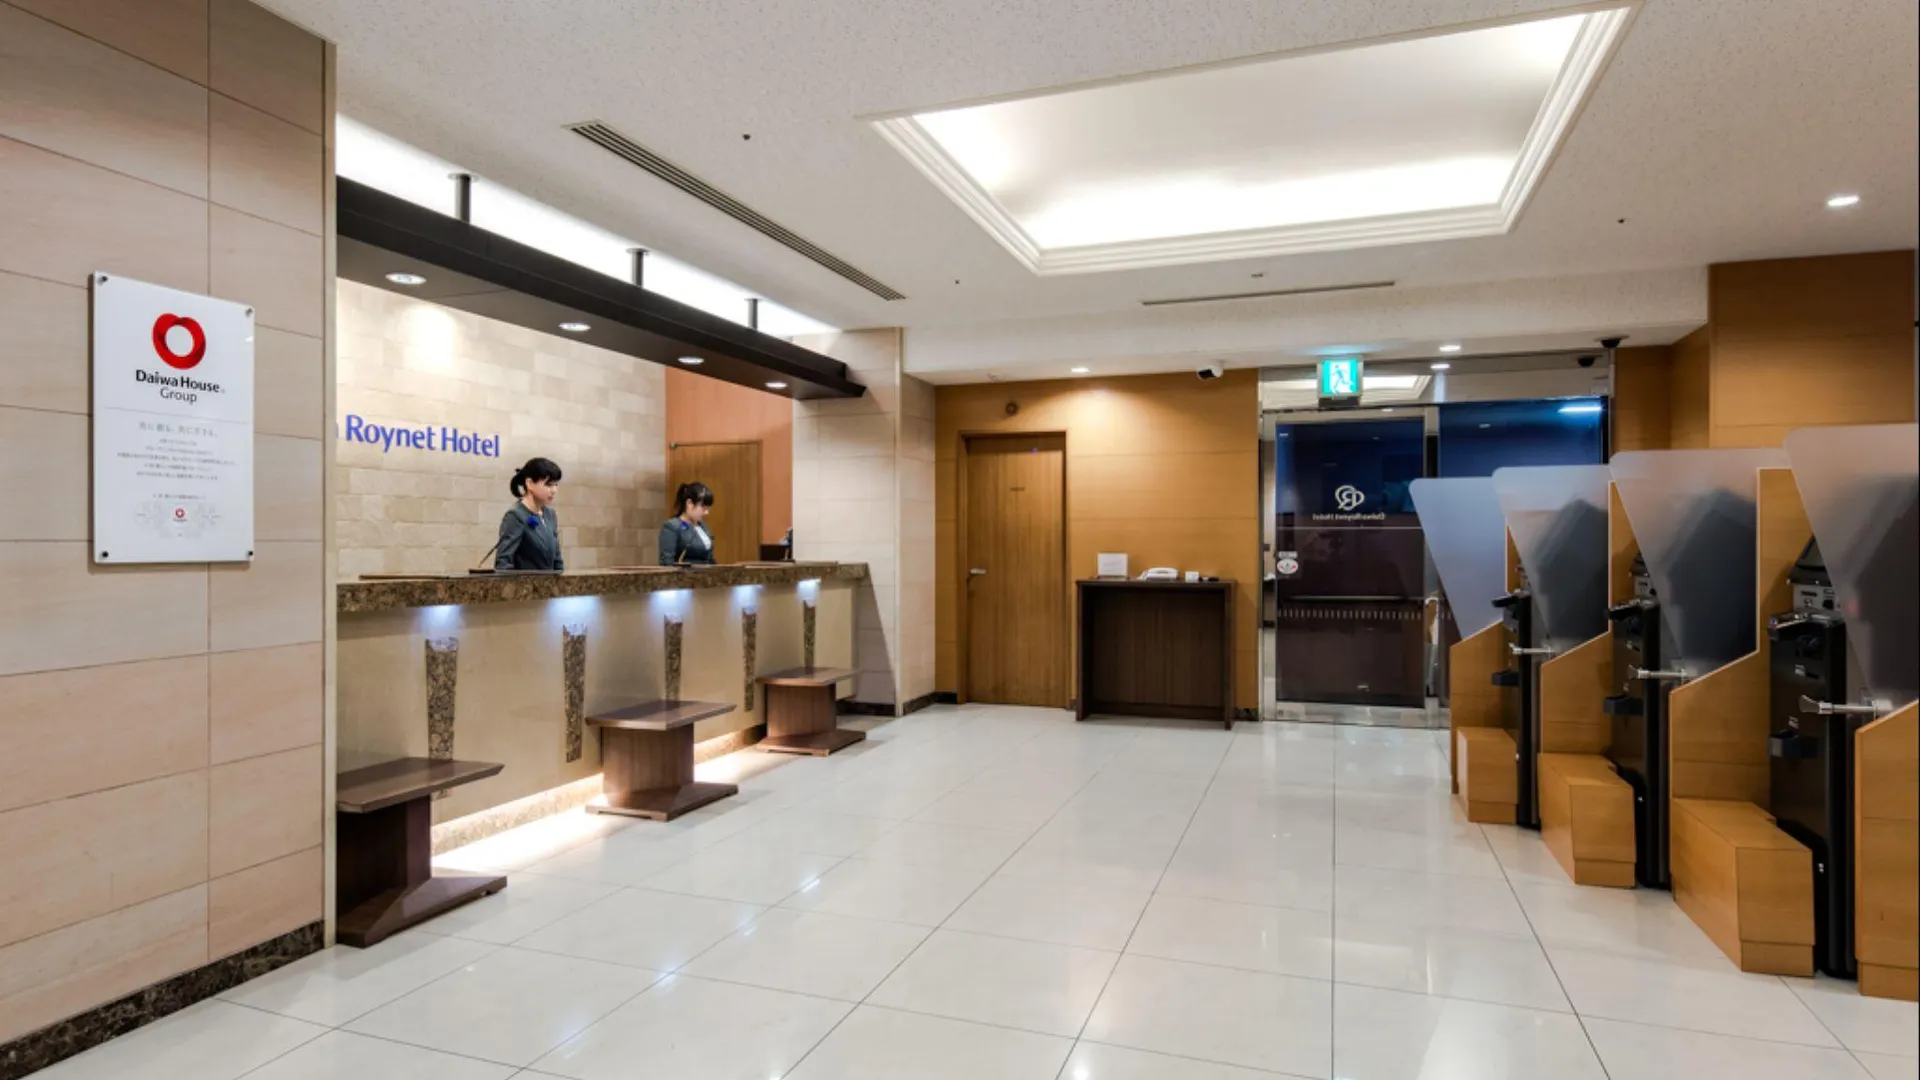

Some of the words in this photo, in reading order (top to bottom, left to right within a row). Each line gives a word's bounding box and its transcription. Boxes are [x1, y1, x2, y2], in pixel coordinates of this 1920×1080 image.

[136, 369, 179, 387] Daiwa
[180, 376, 220, 393] House
[160, 386, 198, 405] Group
[345, 414, 437, 454] Roynet
[441, 426, 500, 458] Hotel
